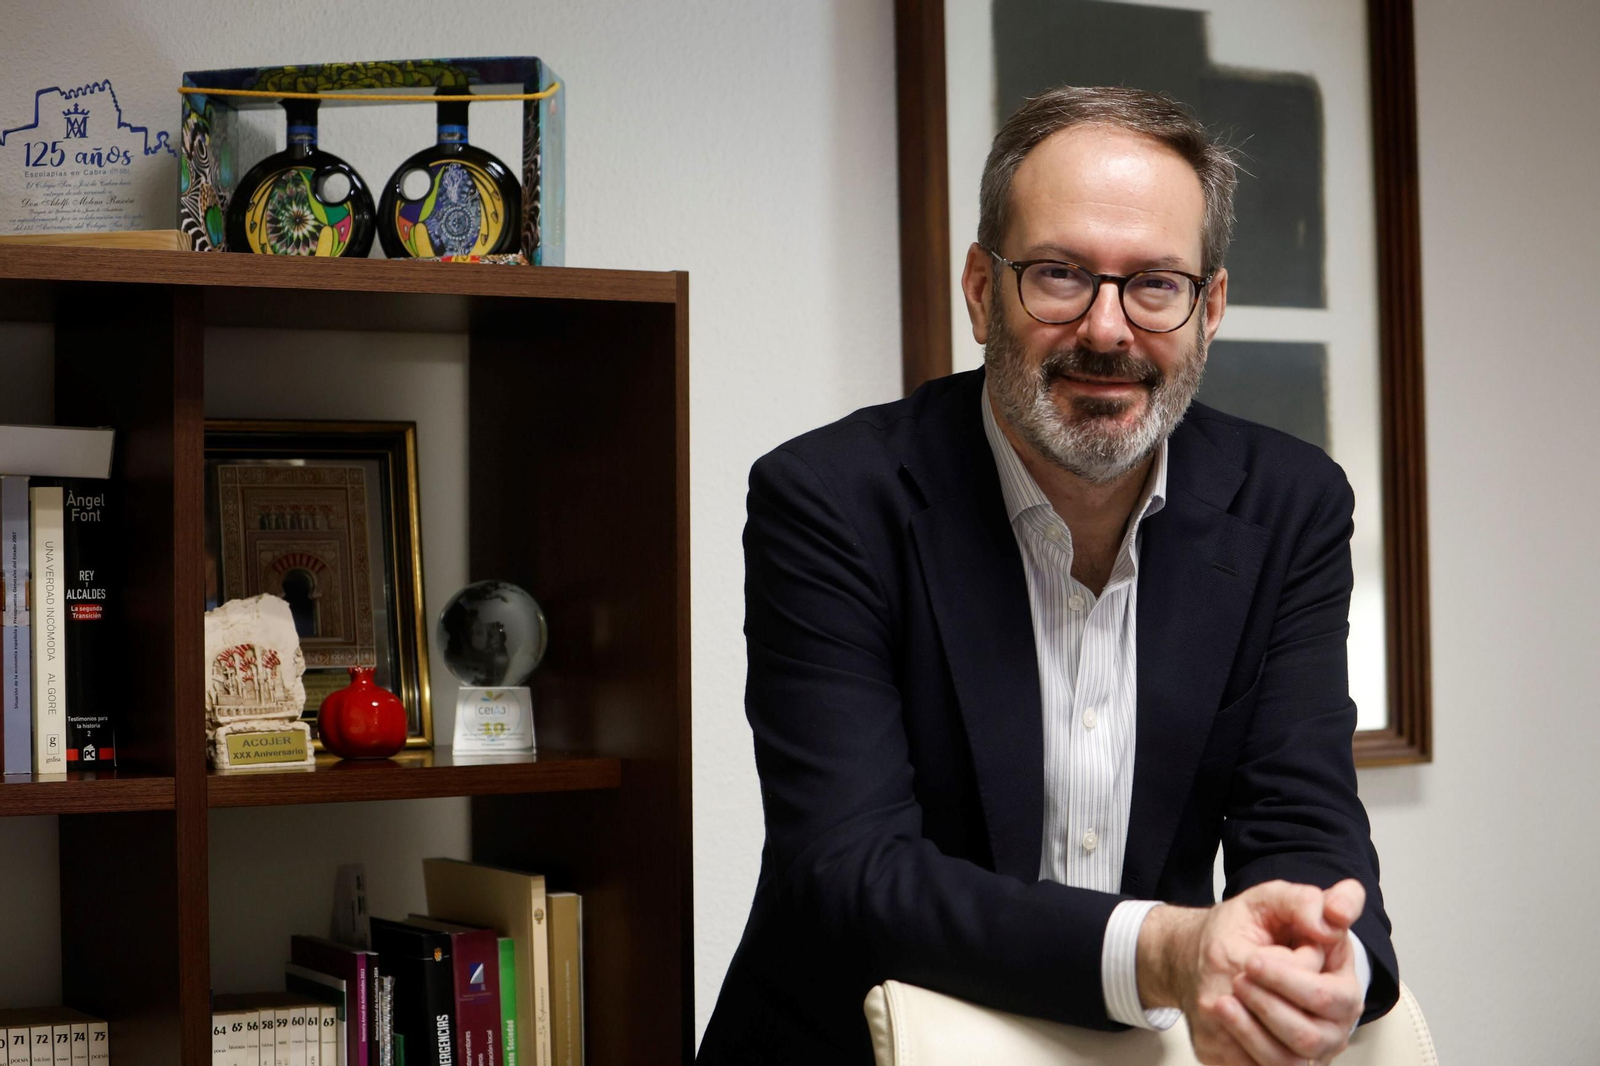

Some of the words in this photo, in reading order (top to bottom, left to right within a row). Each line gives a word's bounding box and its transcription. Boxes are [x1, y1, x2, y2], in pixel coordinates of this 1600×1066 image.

[23, 140, 66, 168] 125
[74, 145, 134, 168] años
[24, 170, 68, 178] Escolapias
[83, 168, 107, 176] Cabra
[21, 197, 39, 208] Don
[71, 509, 101, 522] Font
[45, 540, 54, 563] UNA
[79, 570, 94, 581] REY
[45, 564, 55, 605] VERDAD
[66, 588, 106, 600] ALCALDES
[46, 608, 56, 662] INCÓMODA
[47, 672, 56, 686] AL
[47, 688, 57, 715] GORE
[86, 730, 91, 738] 2
[49, 736, 57, 748] g
[242, 735, 292, 748] ACOJER
[233, 750, 252, 760] XXX
[253, 747, 304, 759] Aniversario
[261, 1020, 274, 1030] 58
[276, 1018, 288, 1028] 59
[291, 1016, 305, 1026] 60
[307, 1016, 318, 1026] 61
[323, 1017, 335, 1027] 63
[213, 1026, 227, 1036] 64
[231, 1022, 243, 1032] 65
[13, 1035, 25, 1045] 71
[36, 1034, 49, 1044] 72
[56, 1033, 68, 1044] 73
[74, 1032, 86, 1042] 74
[94, 1031, 106, 1041] 75
[485, 1029, 494, 1044] local
[505, 1019, 515, 1051] Sociedad
